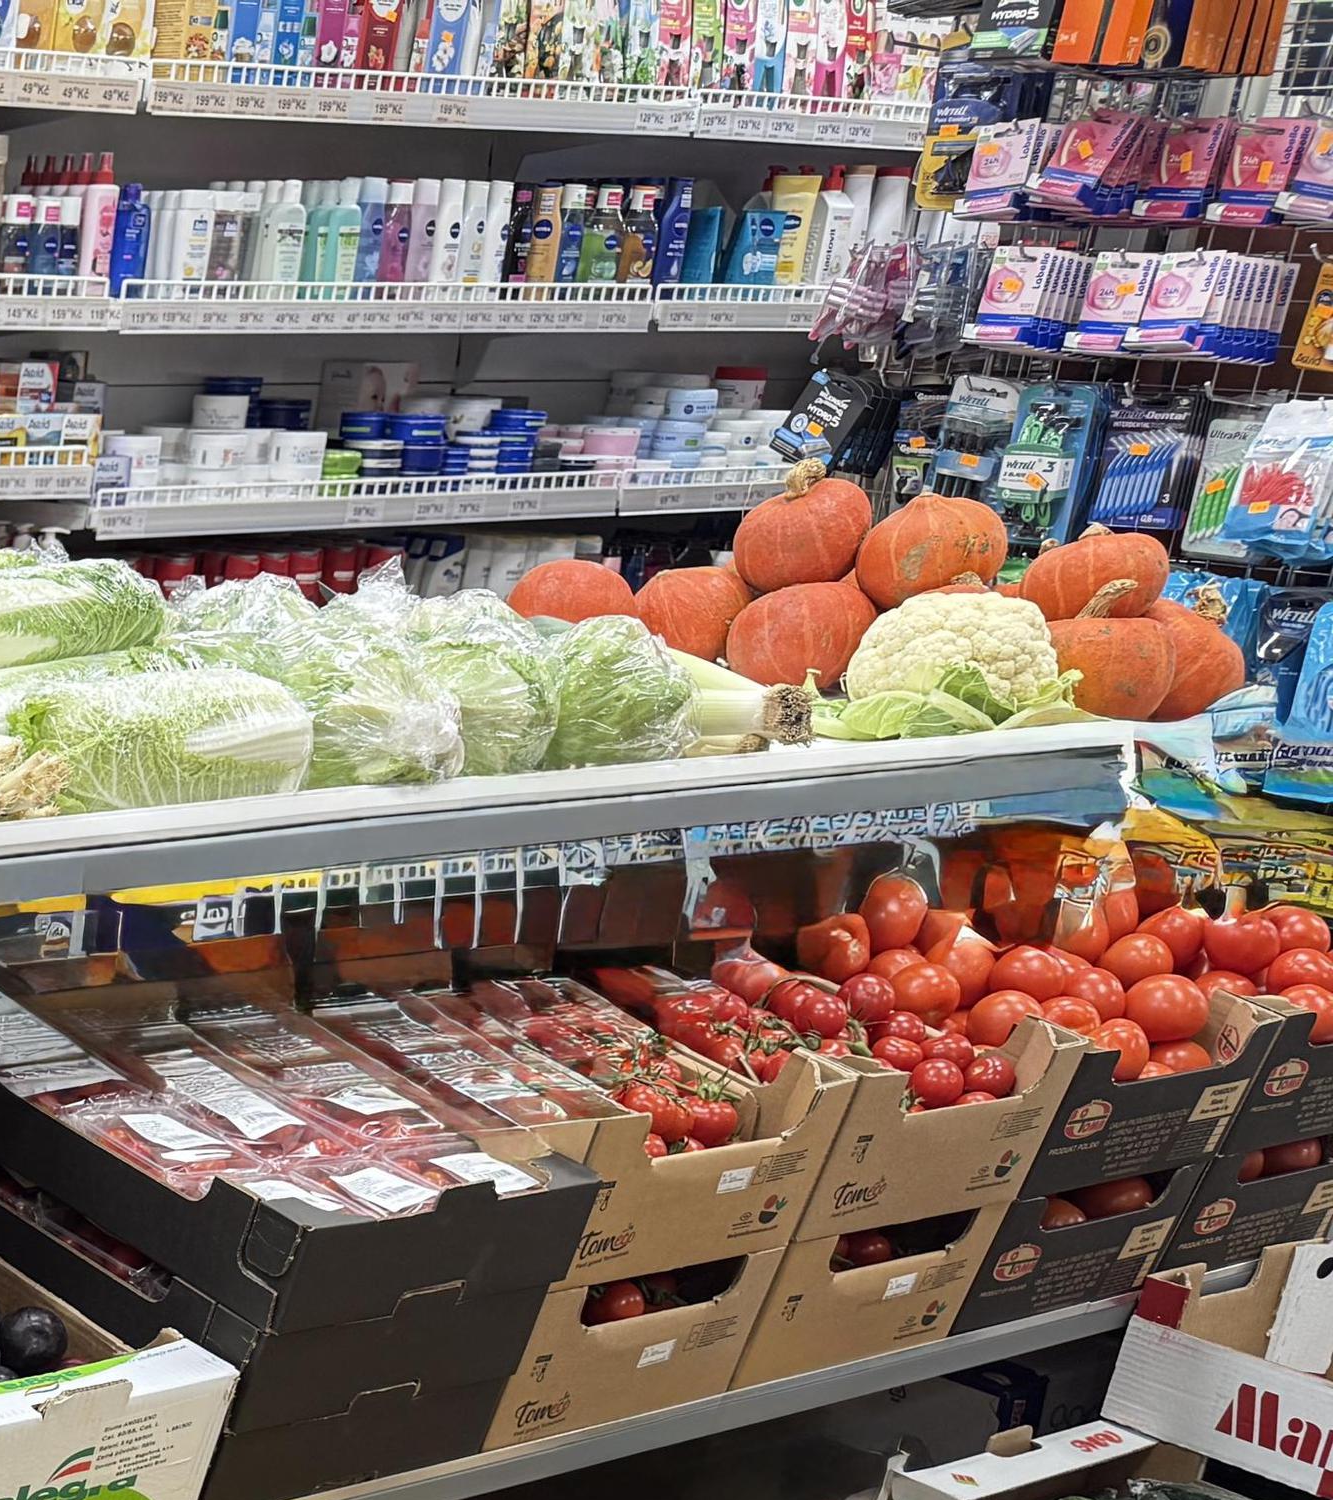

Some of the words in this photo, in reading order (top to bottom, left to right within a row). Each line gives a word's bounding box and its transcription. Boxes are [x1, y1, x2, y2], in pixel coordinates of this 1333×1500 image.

[1205, 122, 1223, 161] Labello
[1281, 125, 1300, 165] Labello
[1033, 253, 1050, 289] Labello
[1135, 259, 1153, 296] Labello
[1201, 255, 1220, 293] Labello
[1215, 258, 1232, 296] Labello
[1210, 430, 1248, 441] UltraPik
